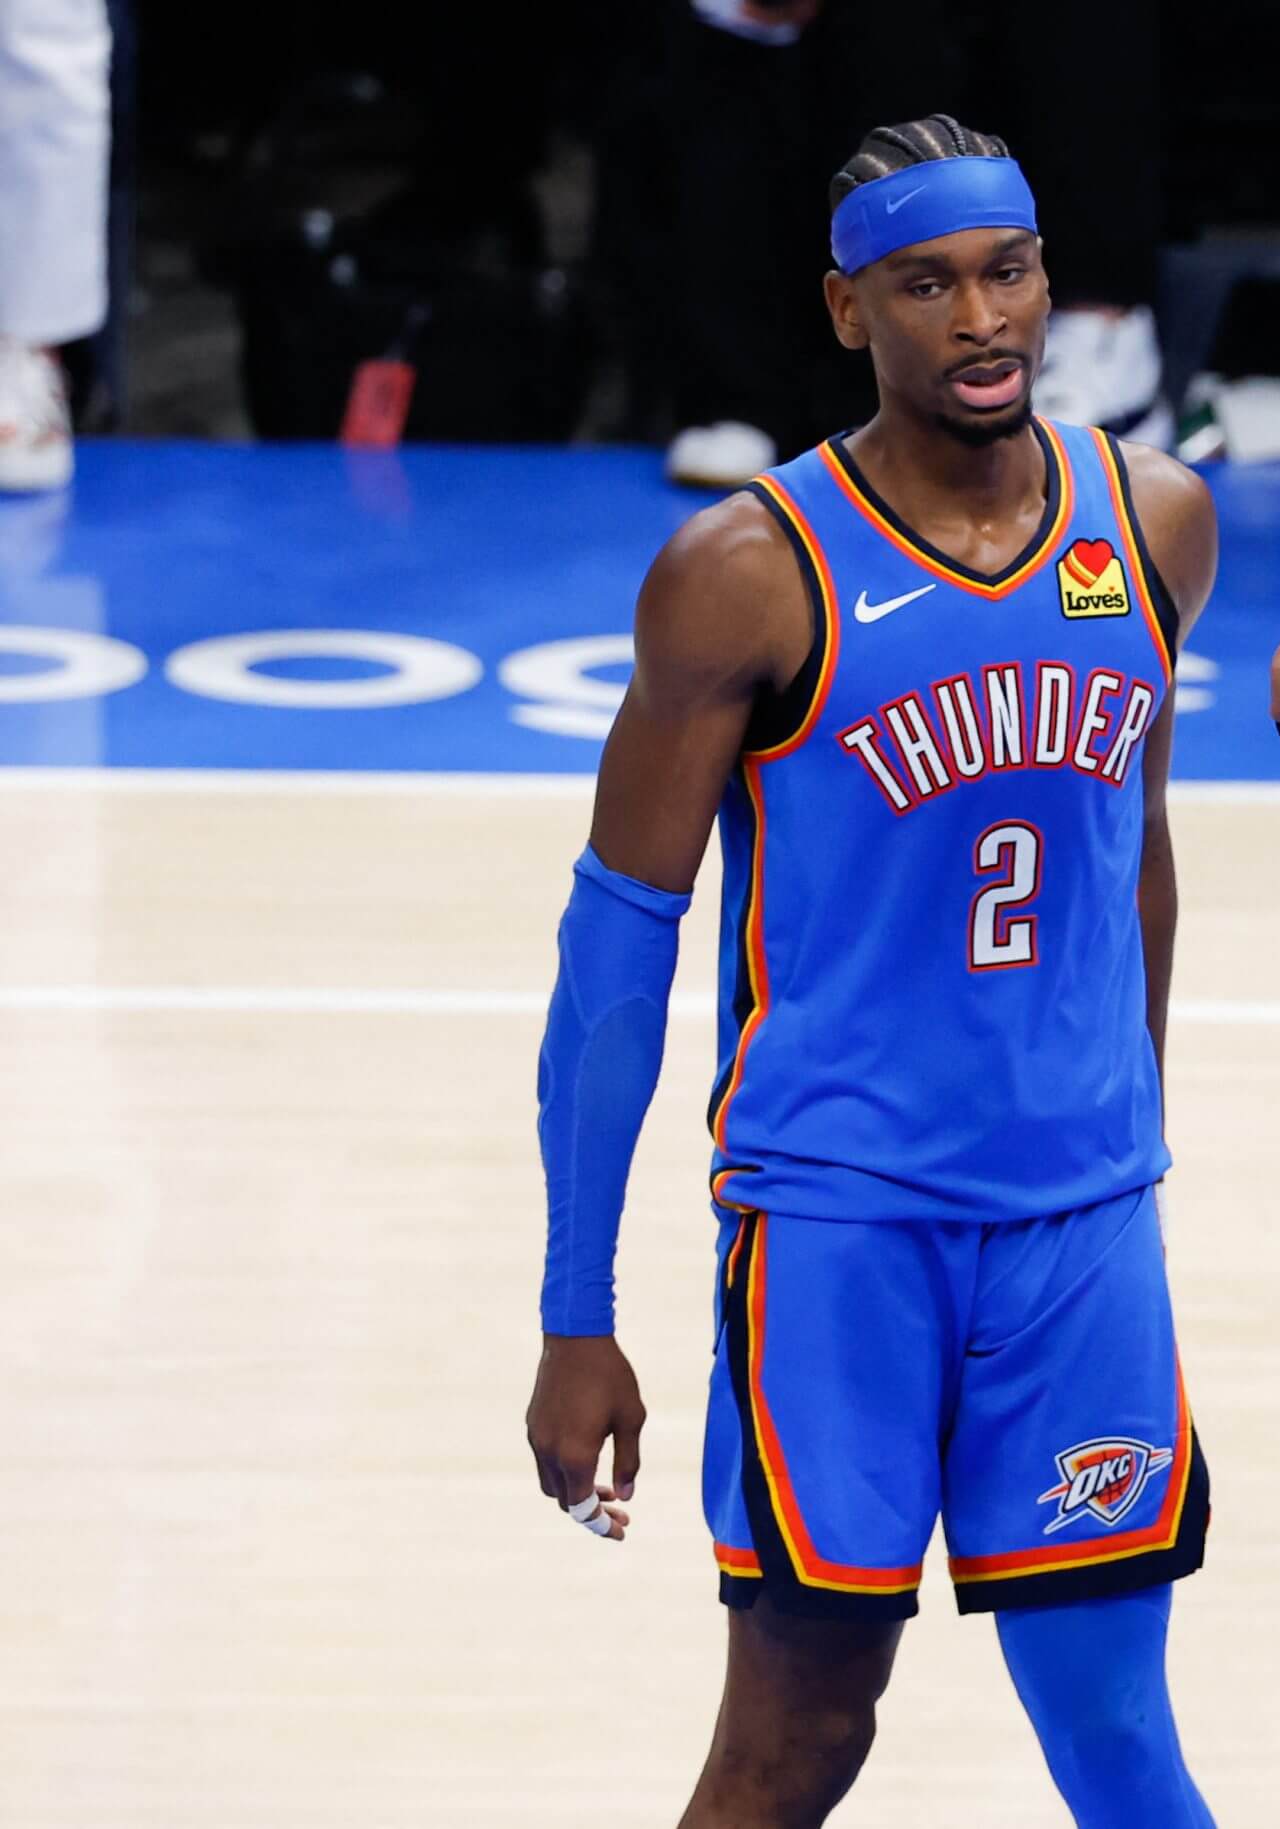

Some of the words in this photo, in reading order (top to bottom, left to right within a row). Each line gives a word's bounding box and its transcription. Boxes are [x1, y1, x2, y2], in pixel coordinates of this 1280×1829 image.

[836, 661, 1154, 815] THUNDER
[968, 819, 1044, 972] 2
[1064, 1453, 1132, 1511] OKC
